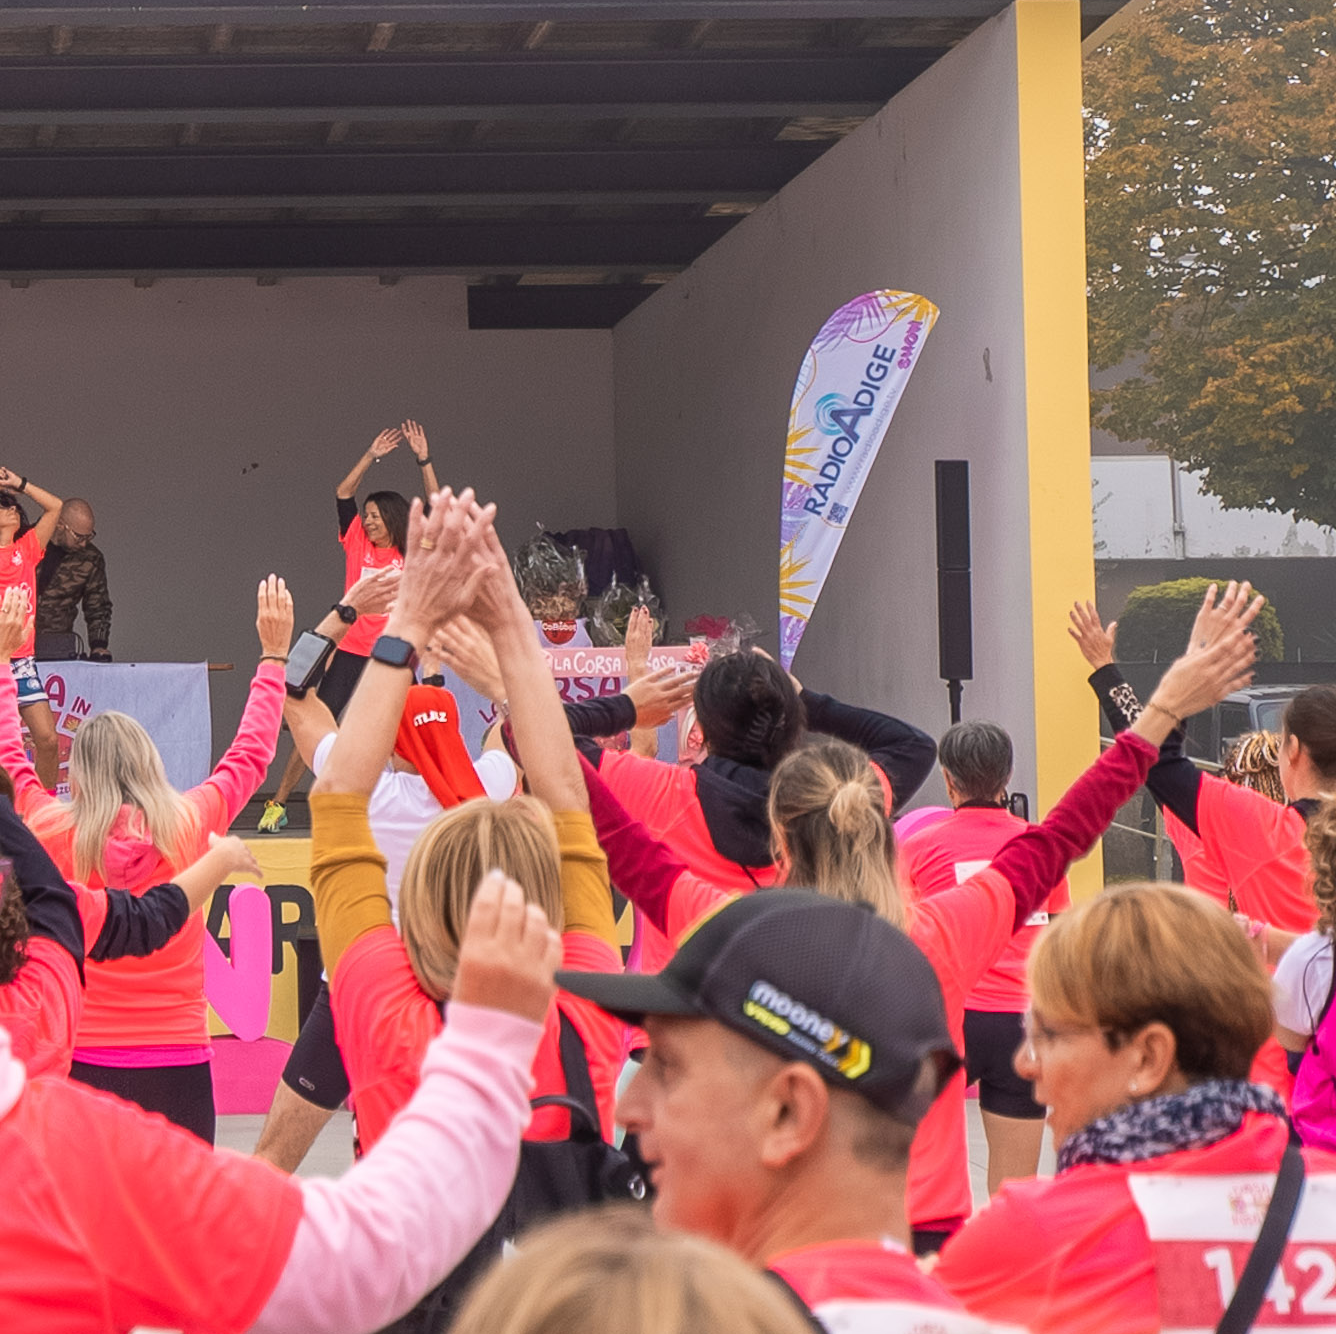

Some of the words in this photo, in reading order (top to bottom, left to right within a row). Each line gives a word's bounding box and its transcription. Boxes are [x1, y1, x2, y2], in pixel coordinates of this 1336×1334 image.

[554, 658, 572, 671] LA
[574, 651, 621, 675] CORSA
[71, 695, 92, 716] IN
[750, 981, 850, 1054] mooney
